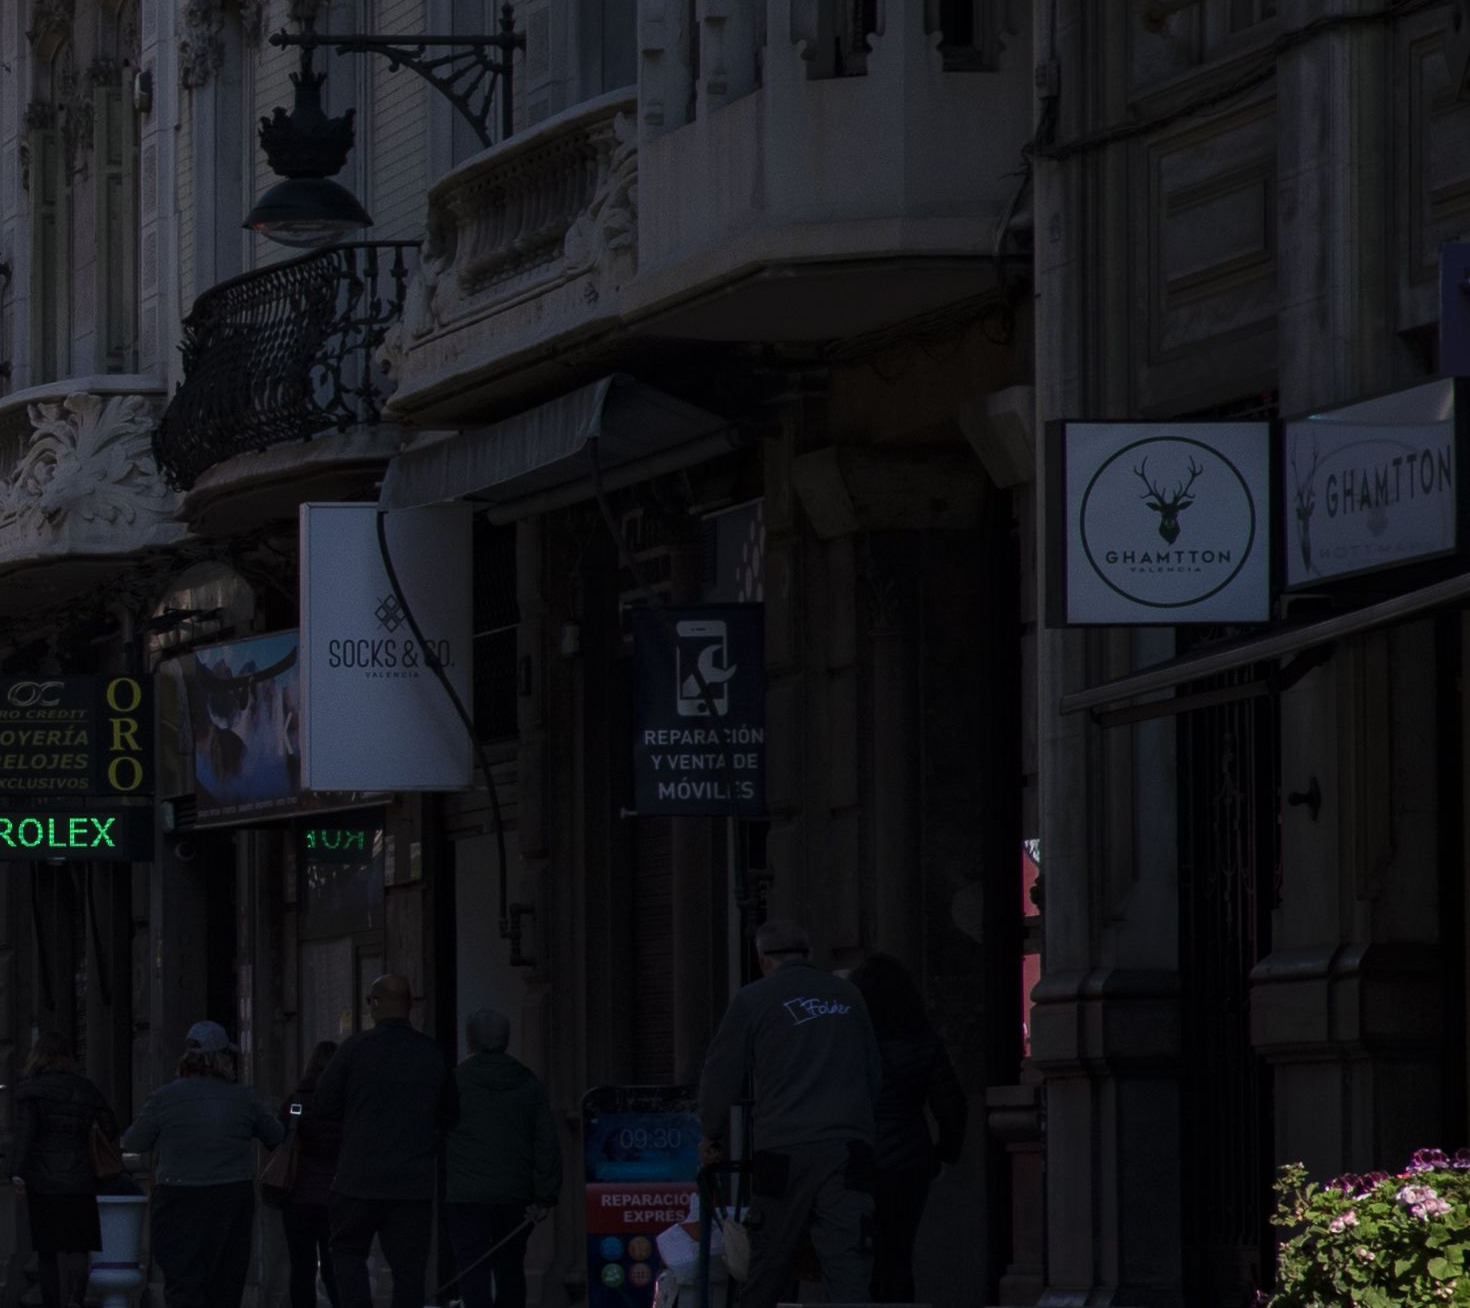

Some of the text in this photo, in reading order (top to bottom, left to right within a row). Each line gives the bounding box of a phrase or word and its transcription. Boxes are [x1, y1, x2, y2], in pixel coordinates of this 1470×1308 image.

[1325, 445, 1453, 519] GHAMTTON
[1105, 549, 1232, 565] GHAMTTON
[328, 639, 398, 668] SOCKS
[401, 639, 419, 668] &
[25, 708, 88, 720] CREDIT
[105, 676, 144, 792] ORO
[650, 753, 759, 770] Y VENTA DE
[658, 776, 755, 800] MÓVILS
[601, 1191, 690, 1207] REPARACIÓ
[623, 1207, 686, 1223] EXPRÉS
